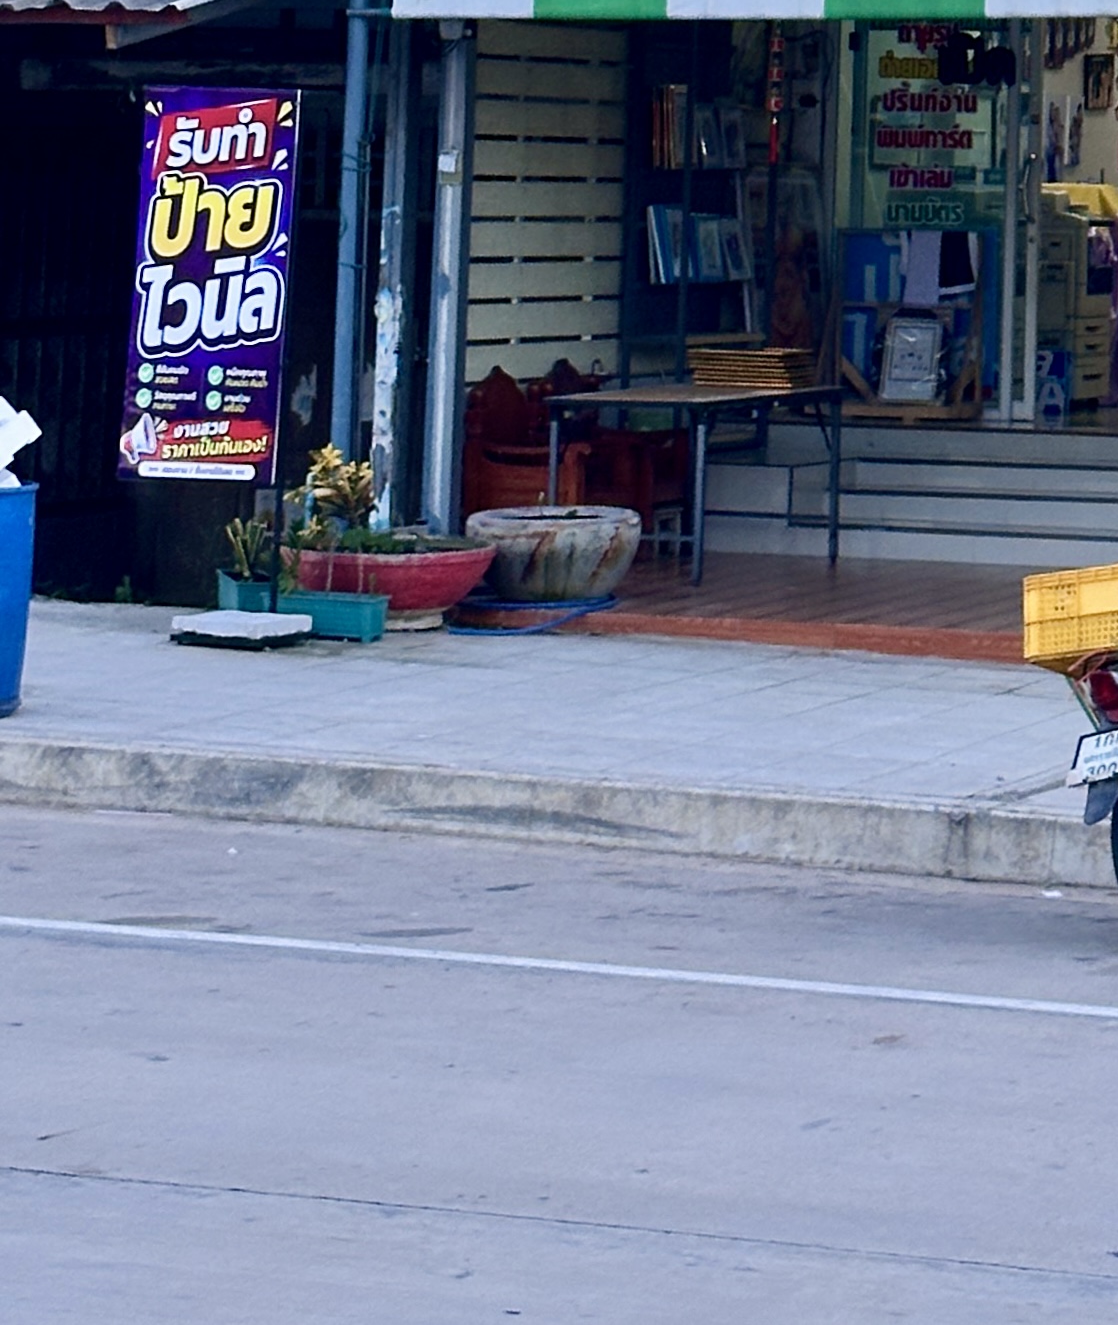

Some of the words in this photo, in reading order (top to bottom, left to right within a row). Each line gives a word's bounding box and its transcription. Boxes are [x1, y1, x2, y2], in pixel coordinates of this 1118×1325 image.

[166, 108, 268, 168] รับทำ
[151, 172, 276, 259] ป้าย
[141, 255, 279, 348] ไวนิล
